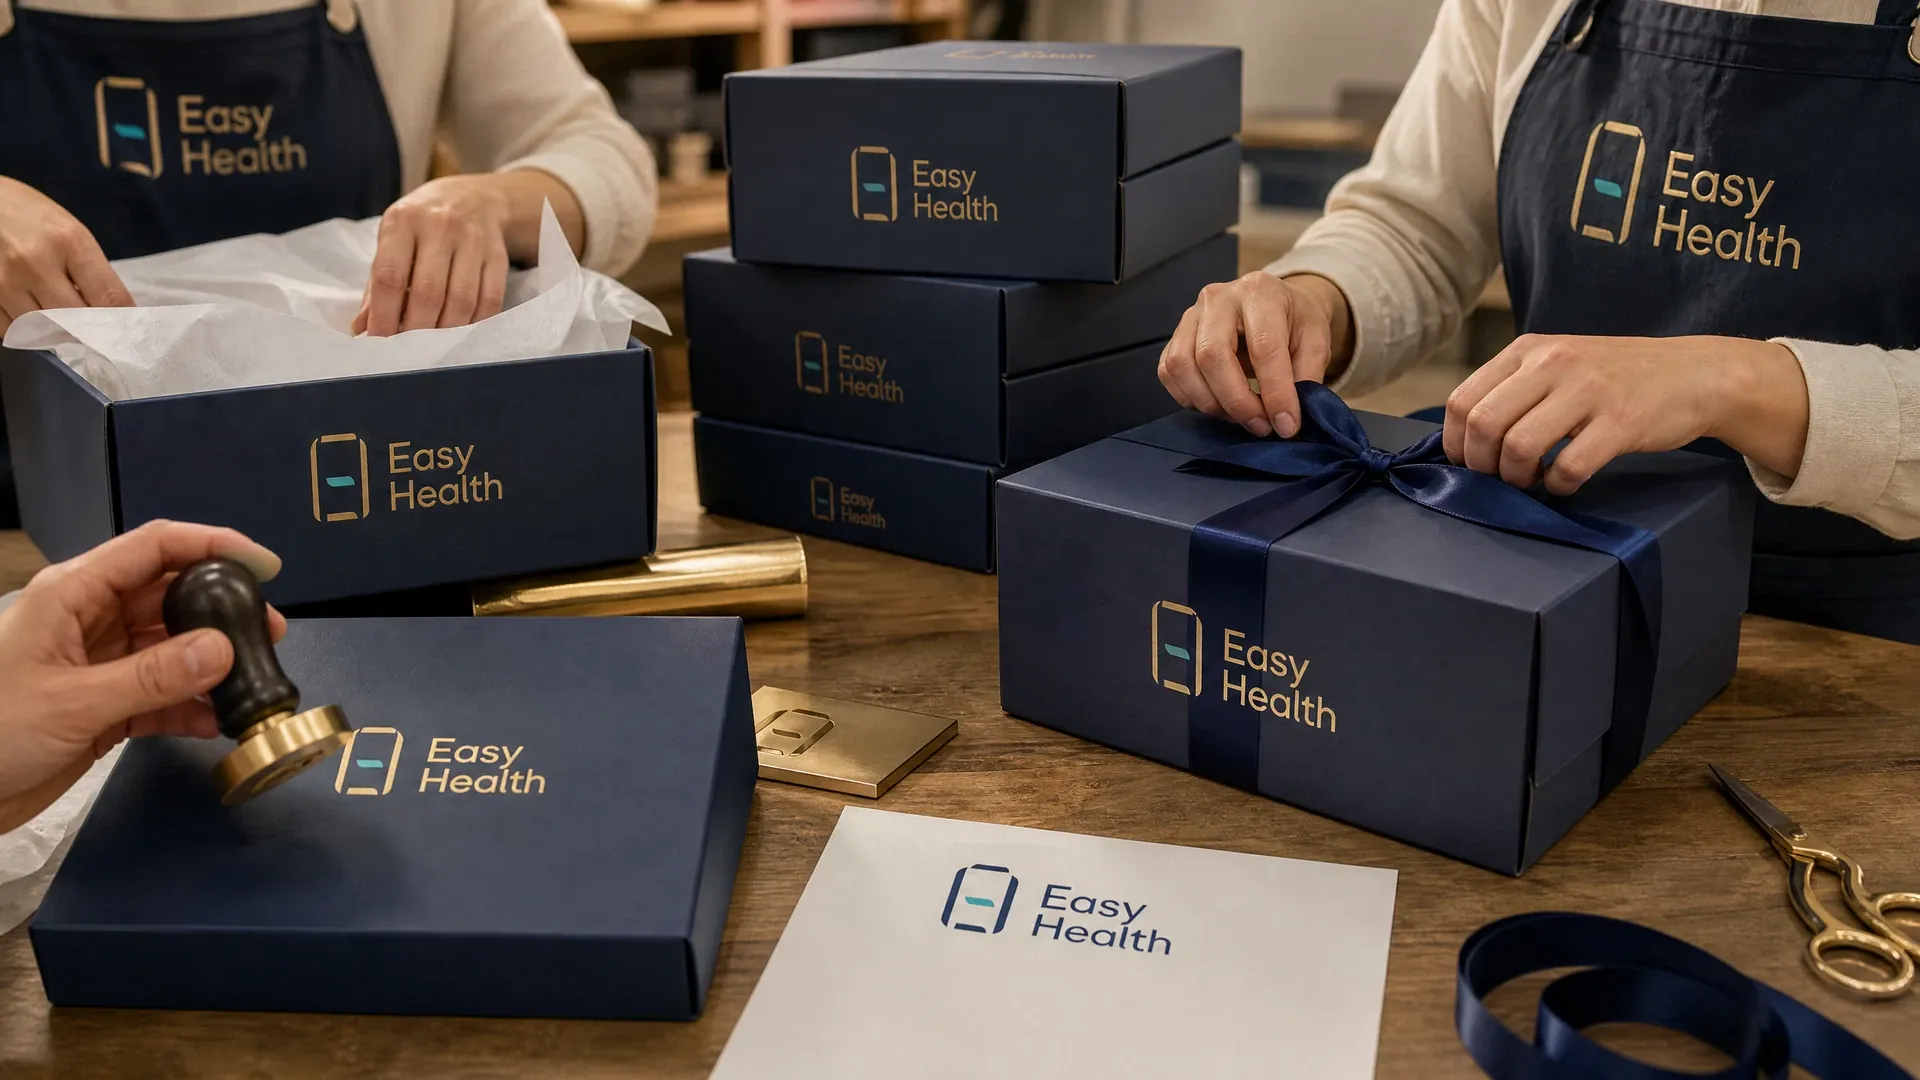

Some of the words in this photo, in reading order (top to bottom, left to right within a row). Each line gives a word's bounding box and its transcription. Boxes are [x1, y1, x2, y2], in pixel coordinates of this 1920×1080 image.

[178, 94, 274, 138] Easy
[181, 137, 307, 176] Health
[912, 160, 977, 195] Easy
[1663, 151, 1775, 220] Easy
[912, 193, 999, 223] Health
[1653, 204, 1802, 270] Health
[838, 346, 888, 378] Easy
[838, 372, 904, 404] Health
[388, 440, 475, 475] Easy
[389, 471, 503, 512] Health
[840, 487, 875, 509] Easy
[840, 507, 886, 530] Health
[1223, 628, 1310, 688] Easy
[1222, 670, 1337, 734] Health
[427, 737, 524, 767] Easy
[419, 768, 546, 795] Health
[1040, 884, 1148, 924] Easy
[1031, 914, 1172, 956] Health
